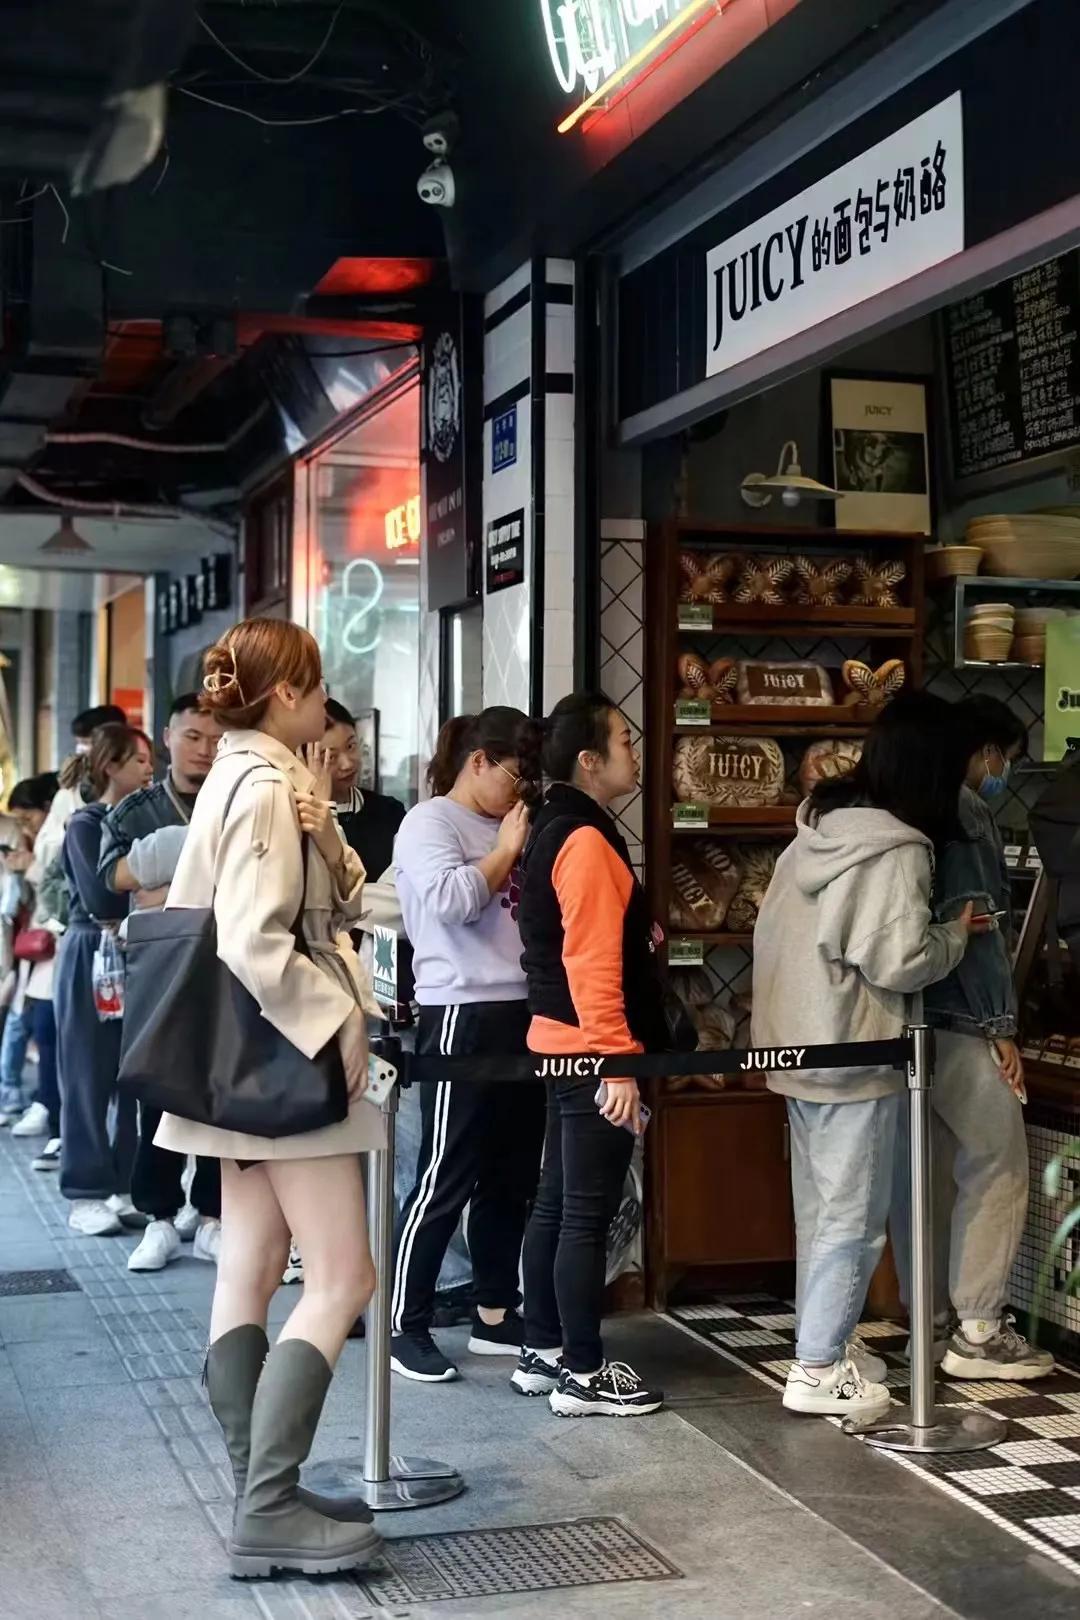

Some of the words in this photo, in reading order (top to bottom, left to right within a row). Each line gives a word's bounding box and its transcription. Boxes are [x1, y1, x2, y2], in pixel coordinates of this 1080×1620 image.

[713, 215, 809, 352] JUICY
[811, 140, 947, 272] 的面包与奶酪
[865, 404, 893, 417] JUICY
[708, 753, 763, 780] JUICY
[534, 1057, 605, 1078] JUICY
[739, 1048, 806, 1070] JUICY
